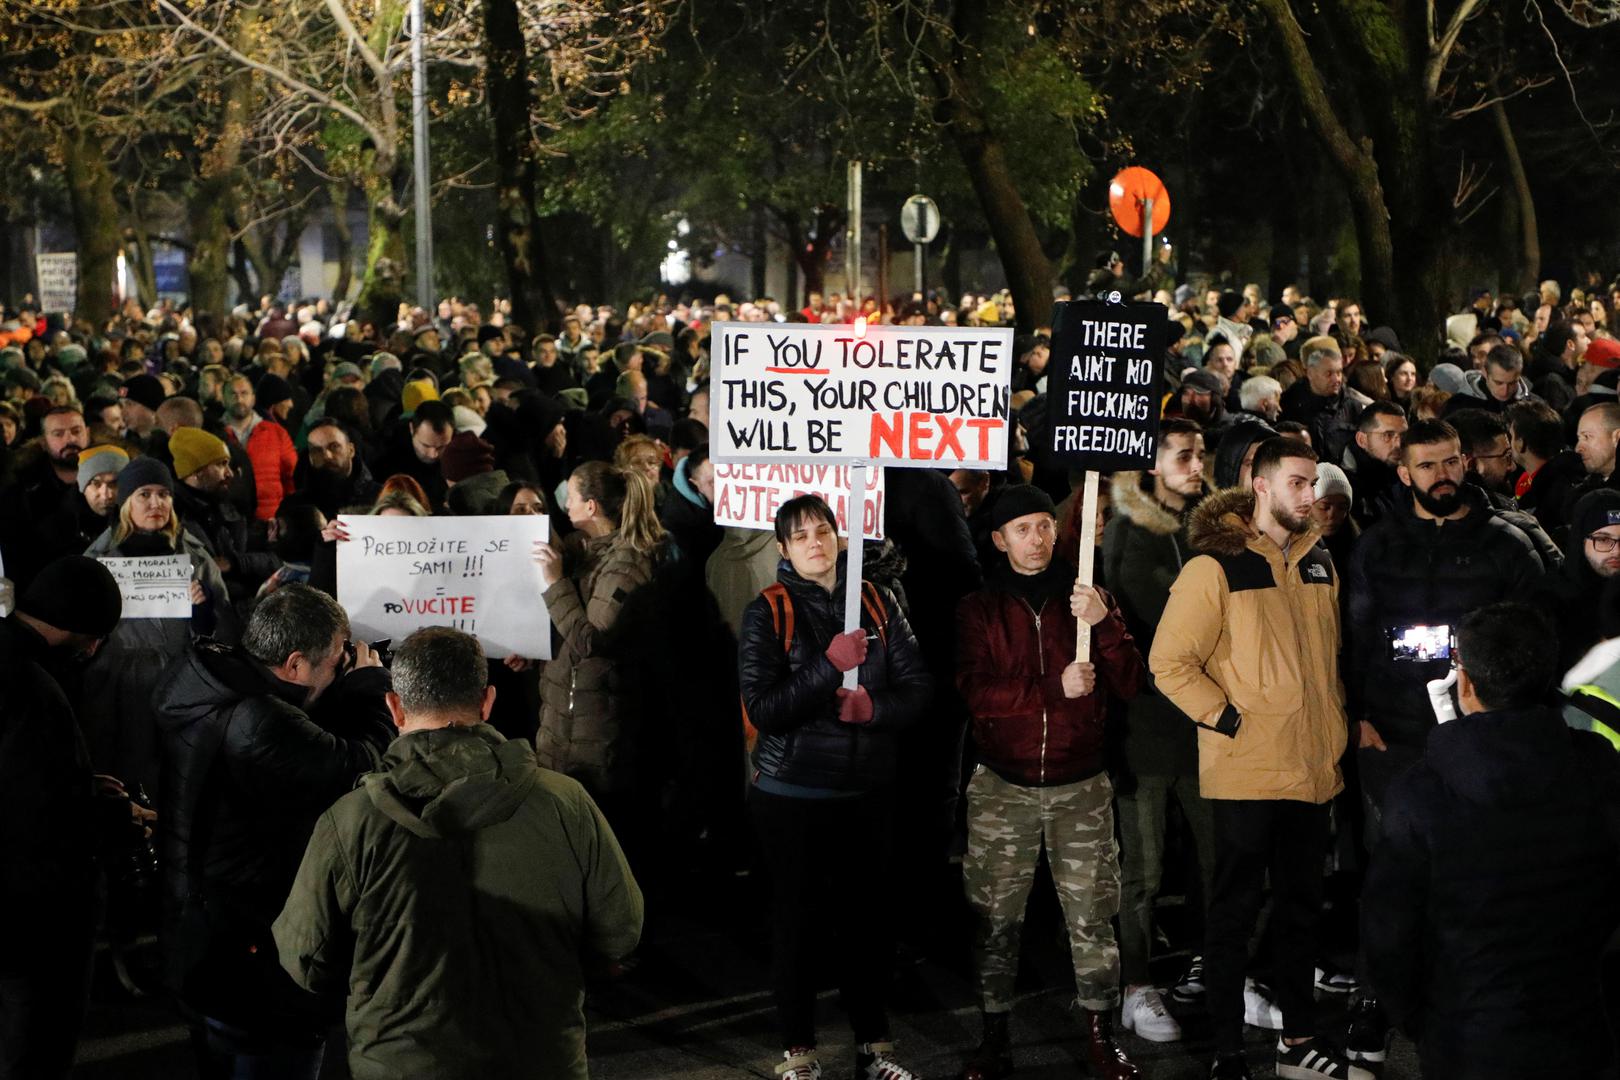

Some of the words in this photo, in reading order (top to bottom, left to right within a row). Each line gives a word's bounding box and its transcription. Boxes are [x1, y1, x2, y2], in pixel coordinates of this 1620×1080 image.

[1082, 320, 1147, 349] THERE
[725, 334, 748, 366] IF
[767, 335, 822, 368] YOU
[834, 338, 1002, 373] TOLERATE
[1126, 358, 1152, 385] NO
[722, 379, 796, 416] THIS,
[804, 378, 877, 412] YOUR
[884, 380, 1009, 421] CHILDREN
[1068, 390, 1149, 420] FUCKING
[727, 419, 797, 451] WILL
[807, 420, 842, 453] BE
[869, 411, 1004, 461] NEXT
[1054, 425, 1153, 459] FREEDOM!
[716, 483, 780, 523] AJTE
[362, 535, 467, 556] PREDLOŽITE
[484, 539, 510, 553] SE
[409, 560, 452, 576] SAMI
